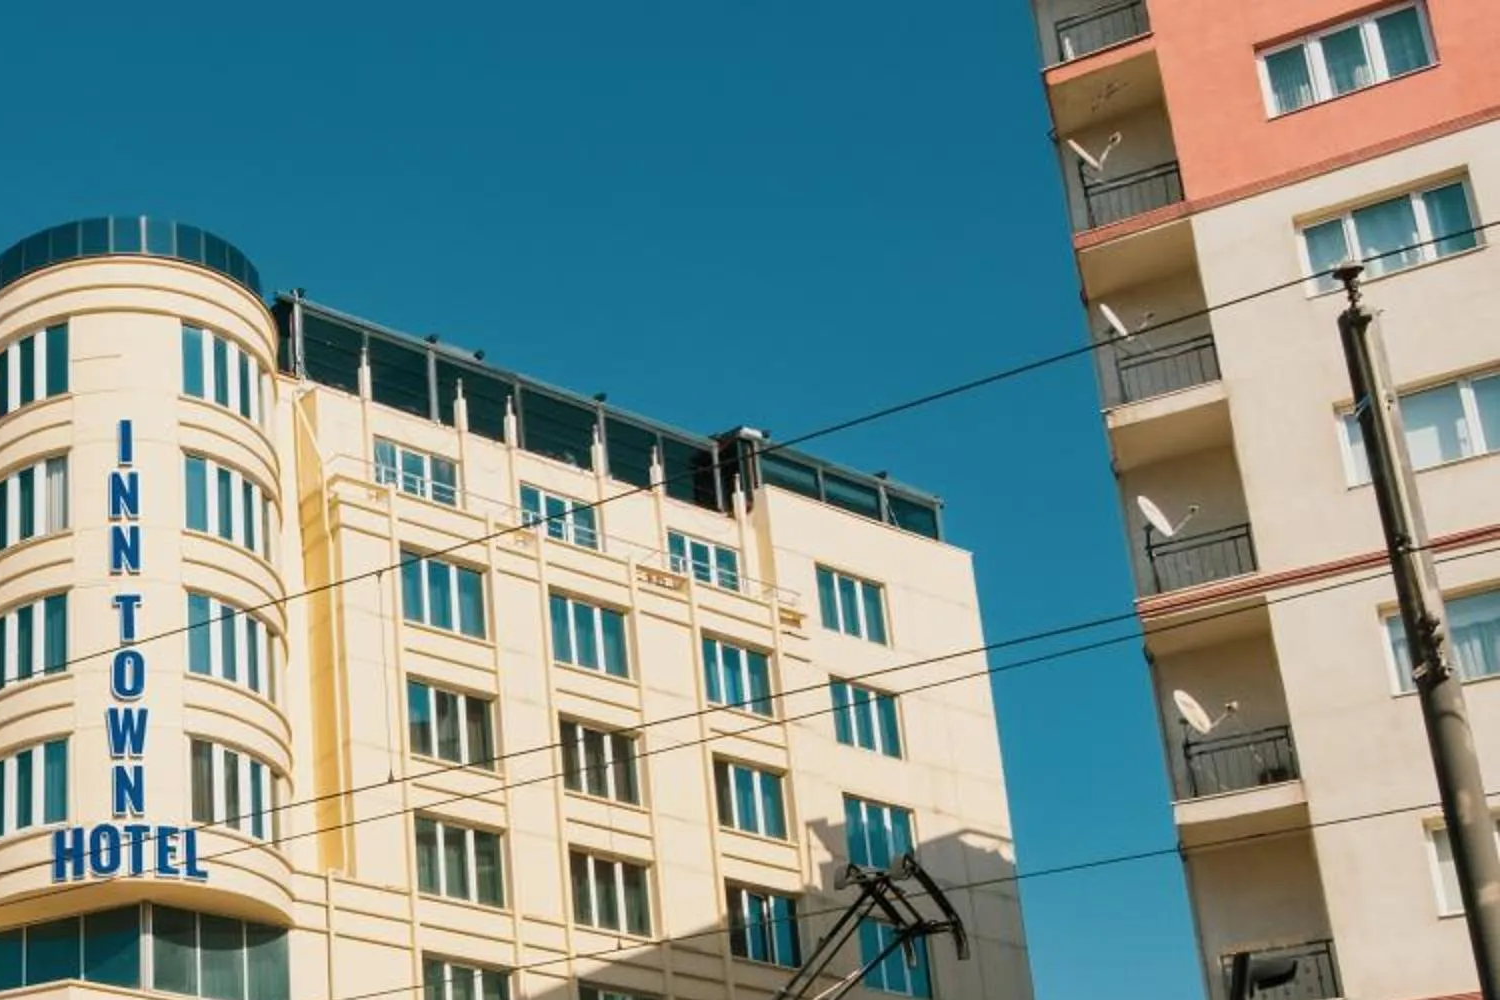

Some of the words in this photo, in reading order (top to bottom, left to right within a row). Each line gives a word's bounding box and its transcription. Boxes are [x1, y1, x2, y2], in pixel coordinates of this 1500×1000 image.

[109, 419, 141, 577] INN
[104, 594, 149, 818] TOWN
[52, 823, 209, 883] HOTEL
